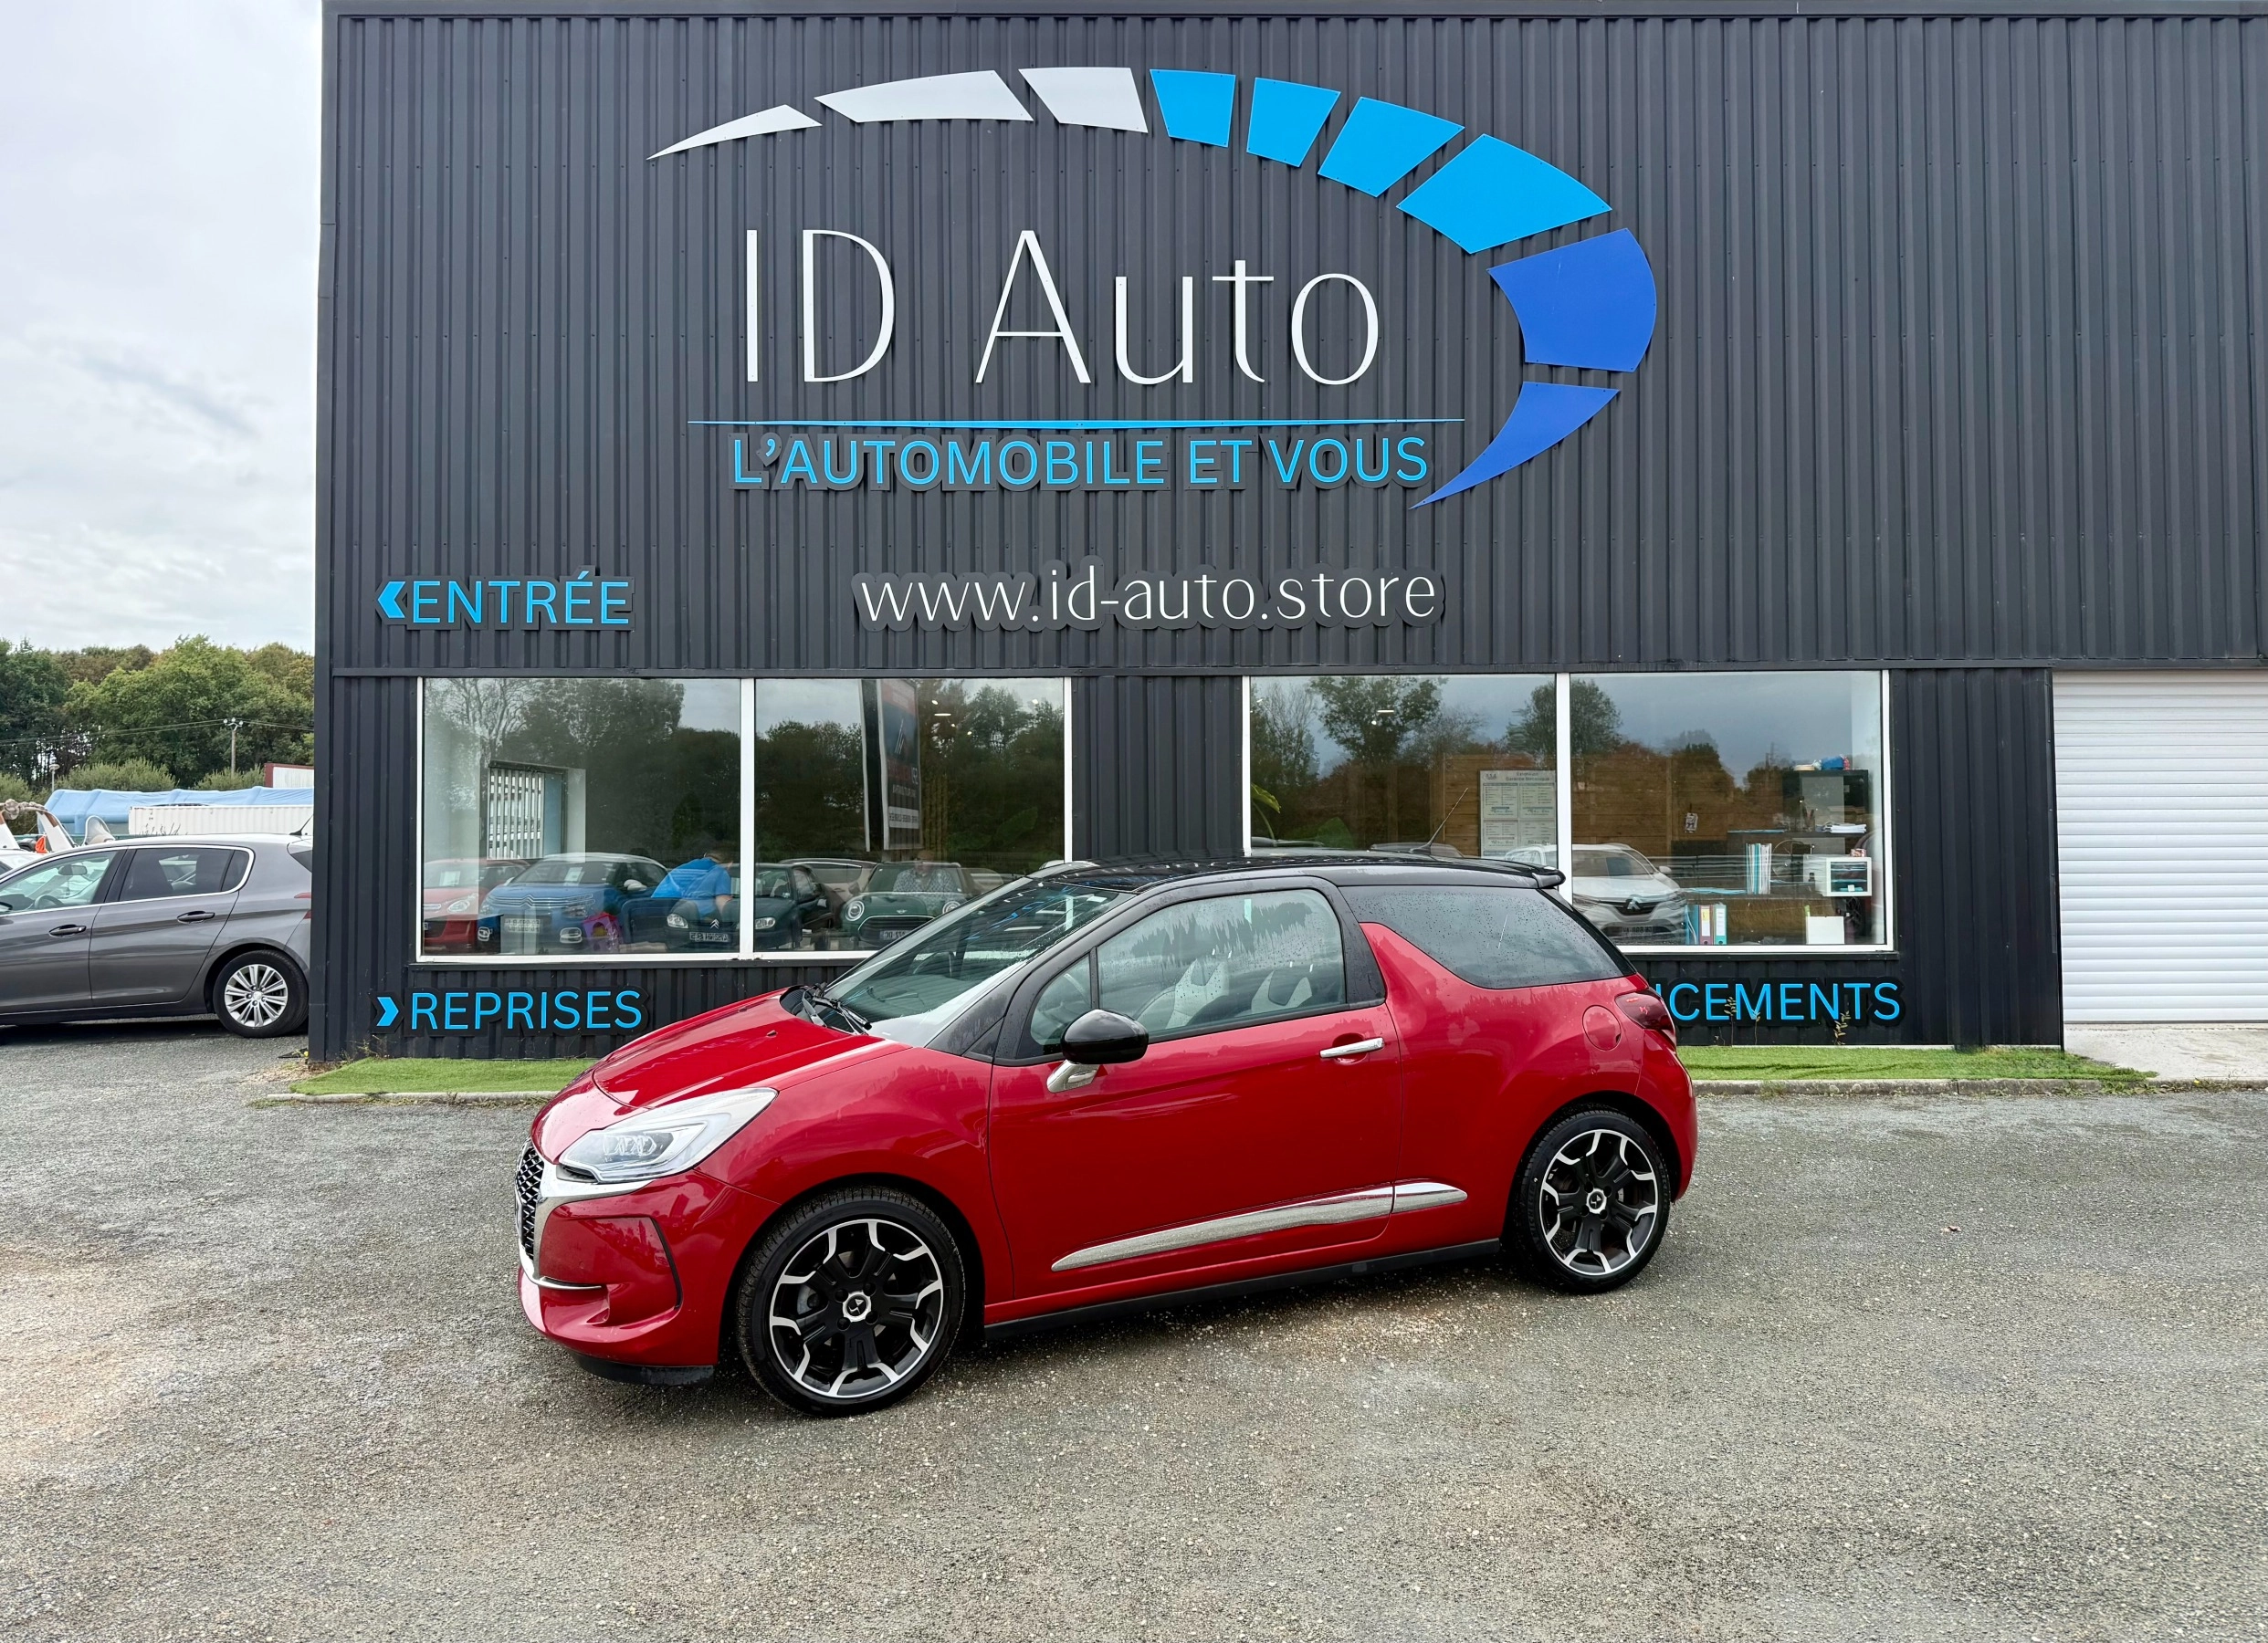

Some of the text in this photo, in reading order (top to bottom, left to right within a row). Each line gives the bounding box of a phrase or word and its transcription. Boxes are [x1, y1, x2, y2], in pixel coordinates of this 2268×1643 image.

[746, 229, 1379, 385] ID Auto
[734, 436, 1428, 486] L’AUTOMOBILE ET VOUS
[413, 570, 629, 624] ENTRÉE
[861, 564, 1435, 625] www.id-auto.store
[411, 989, 642, 1030] REPRISES
